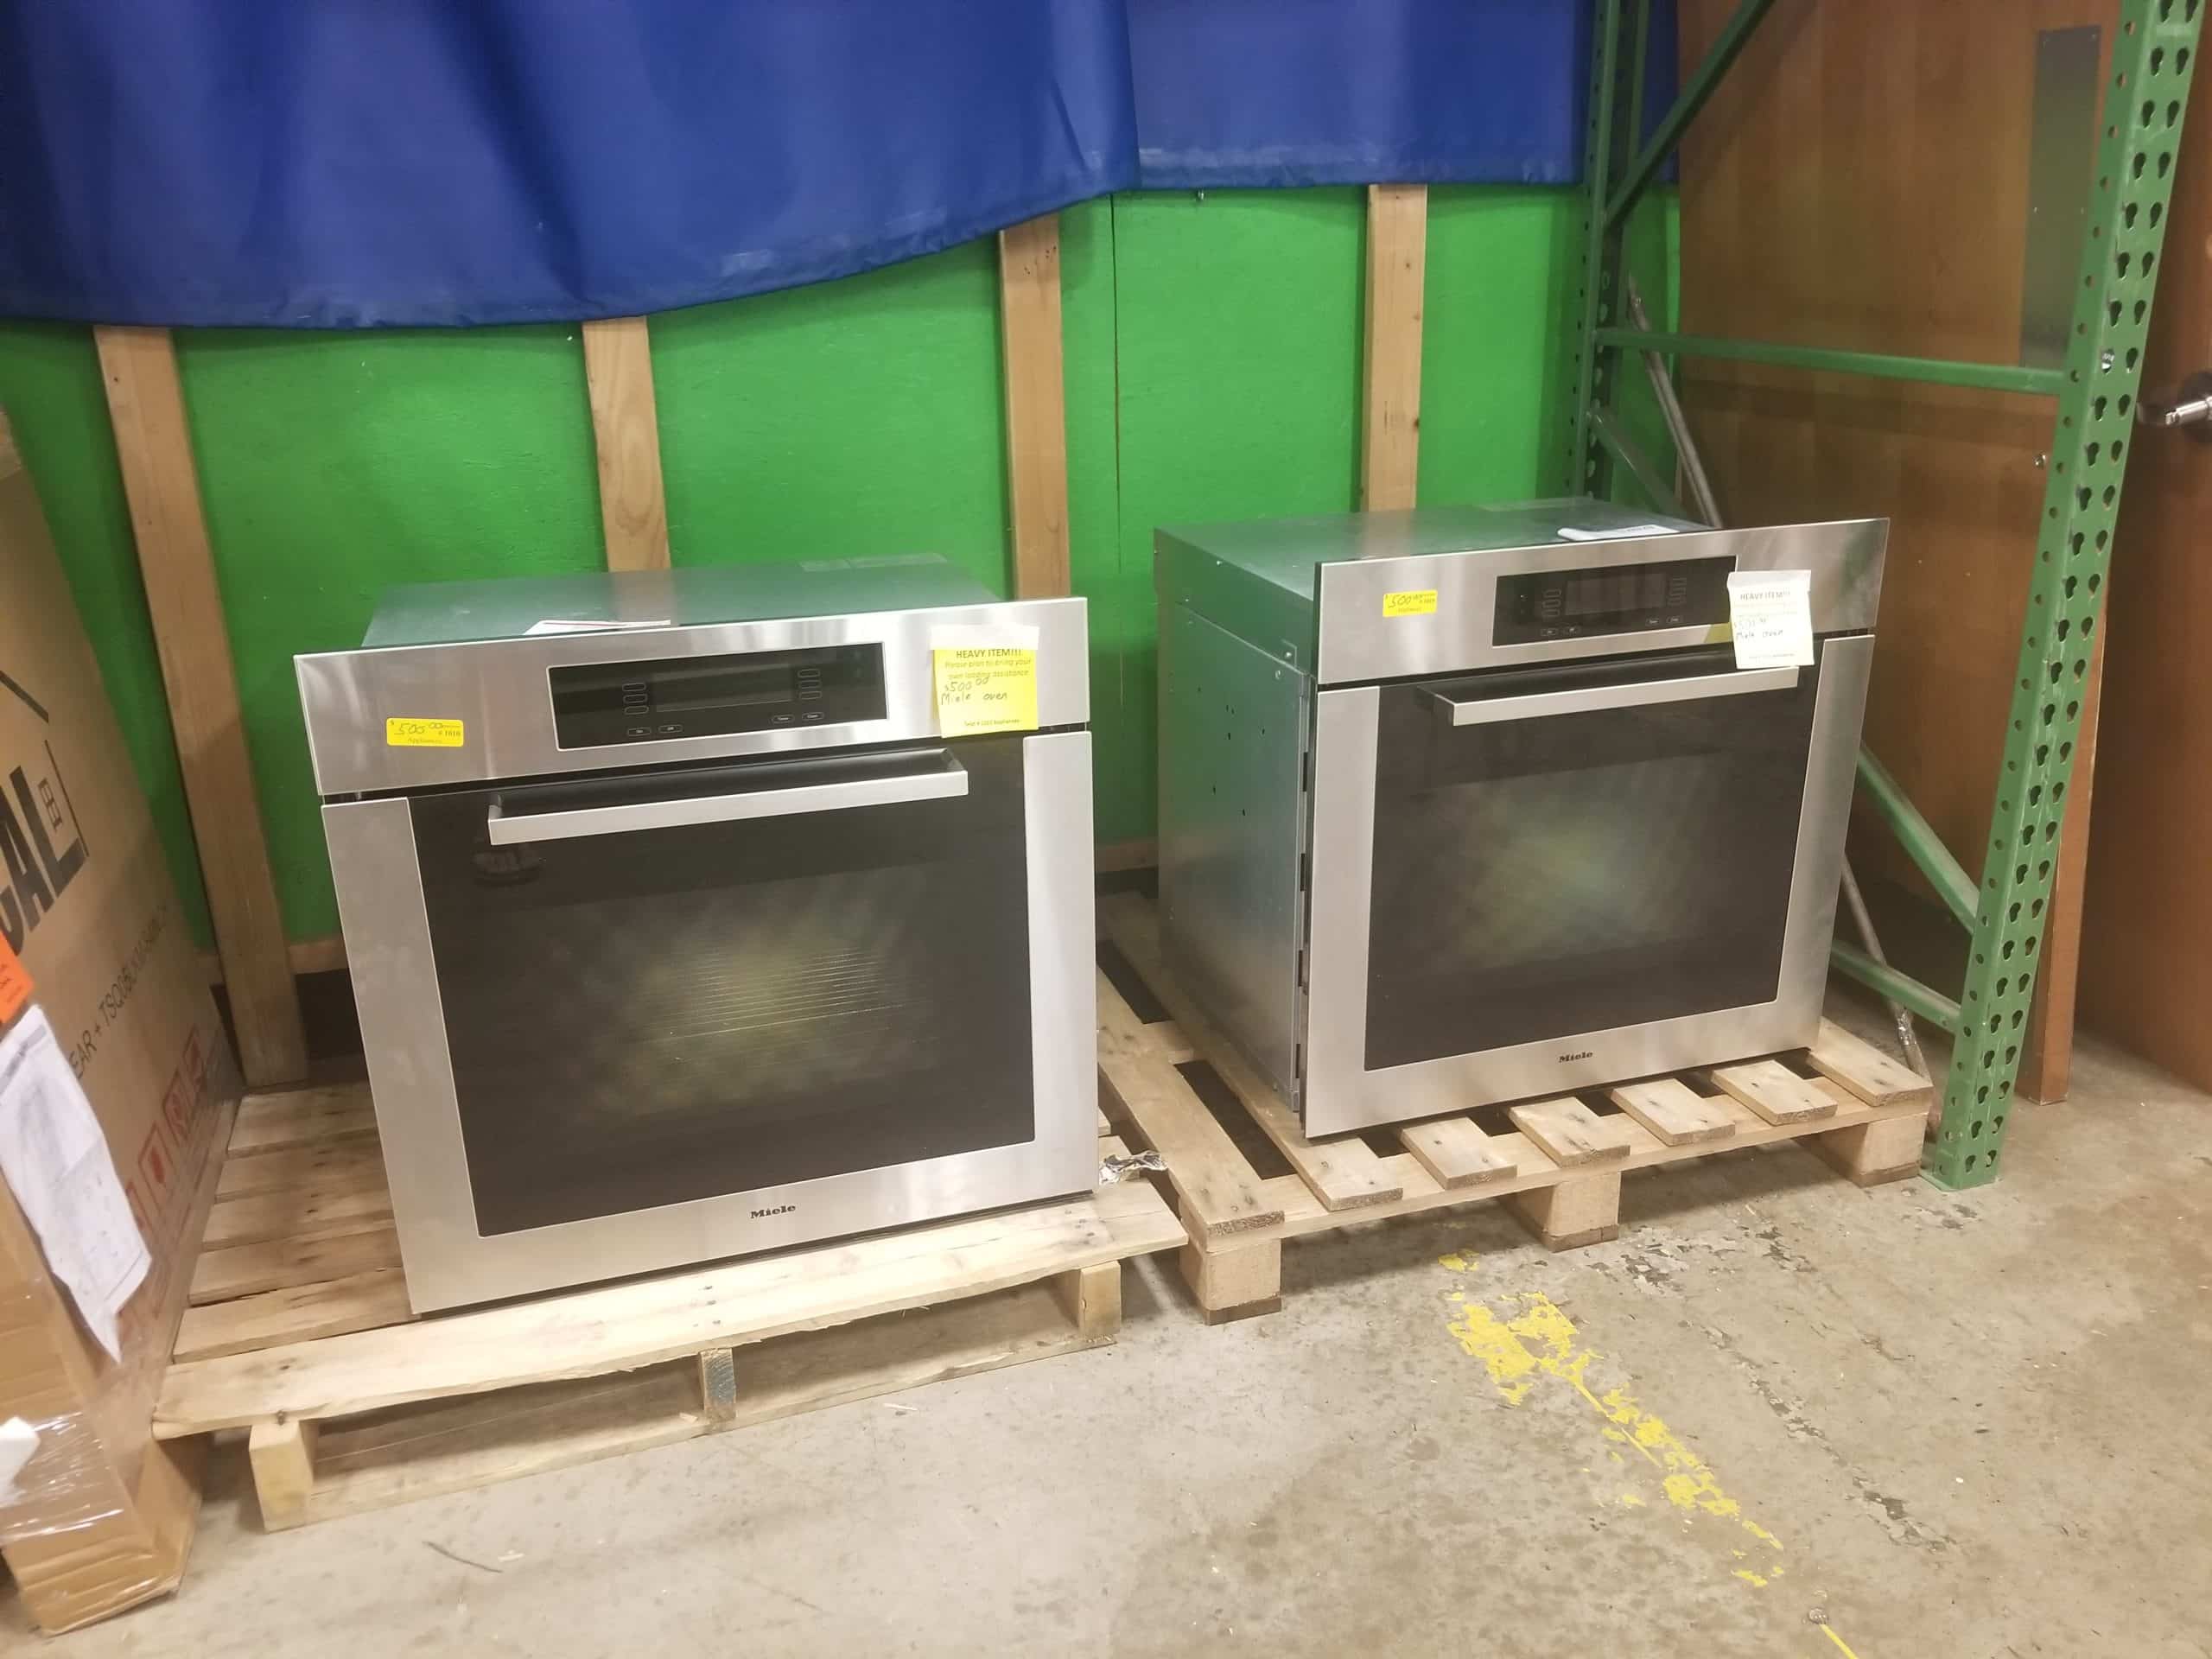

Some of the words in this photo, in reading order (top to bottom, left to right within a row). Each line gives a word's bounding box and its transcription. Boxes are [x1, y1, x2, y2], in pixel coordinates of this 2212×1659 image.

[956, 650, 985, 658] HEAVY
[982, 692, 1007, 701] oven
[1559, 1052, 1593, 1063] Miele
[750, 1205, 796, 1218] Miele
